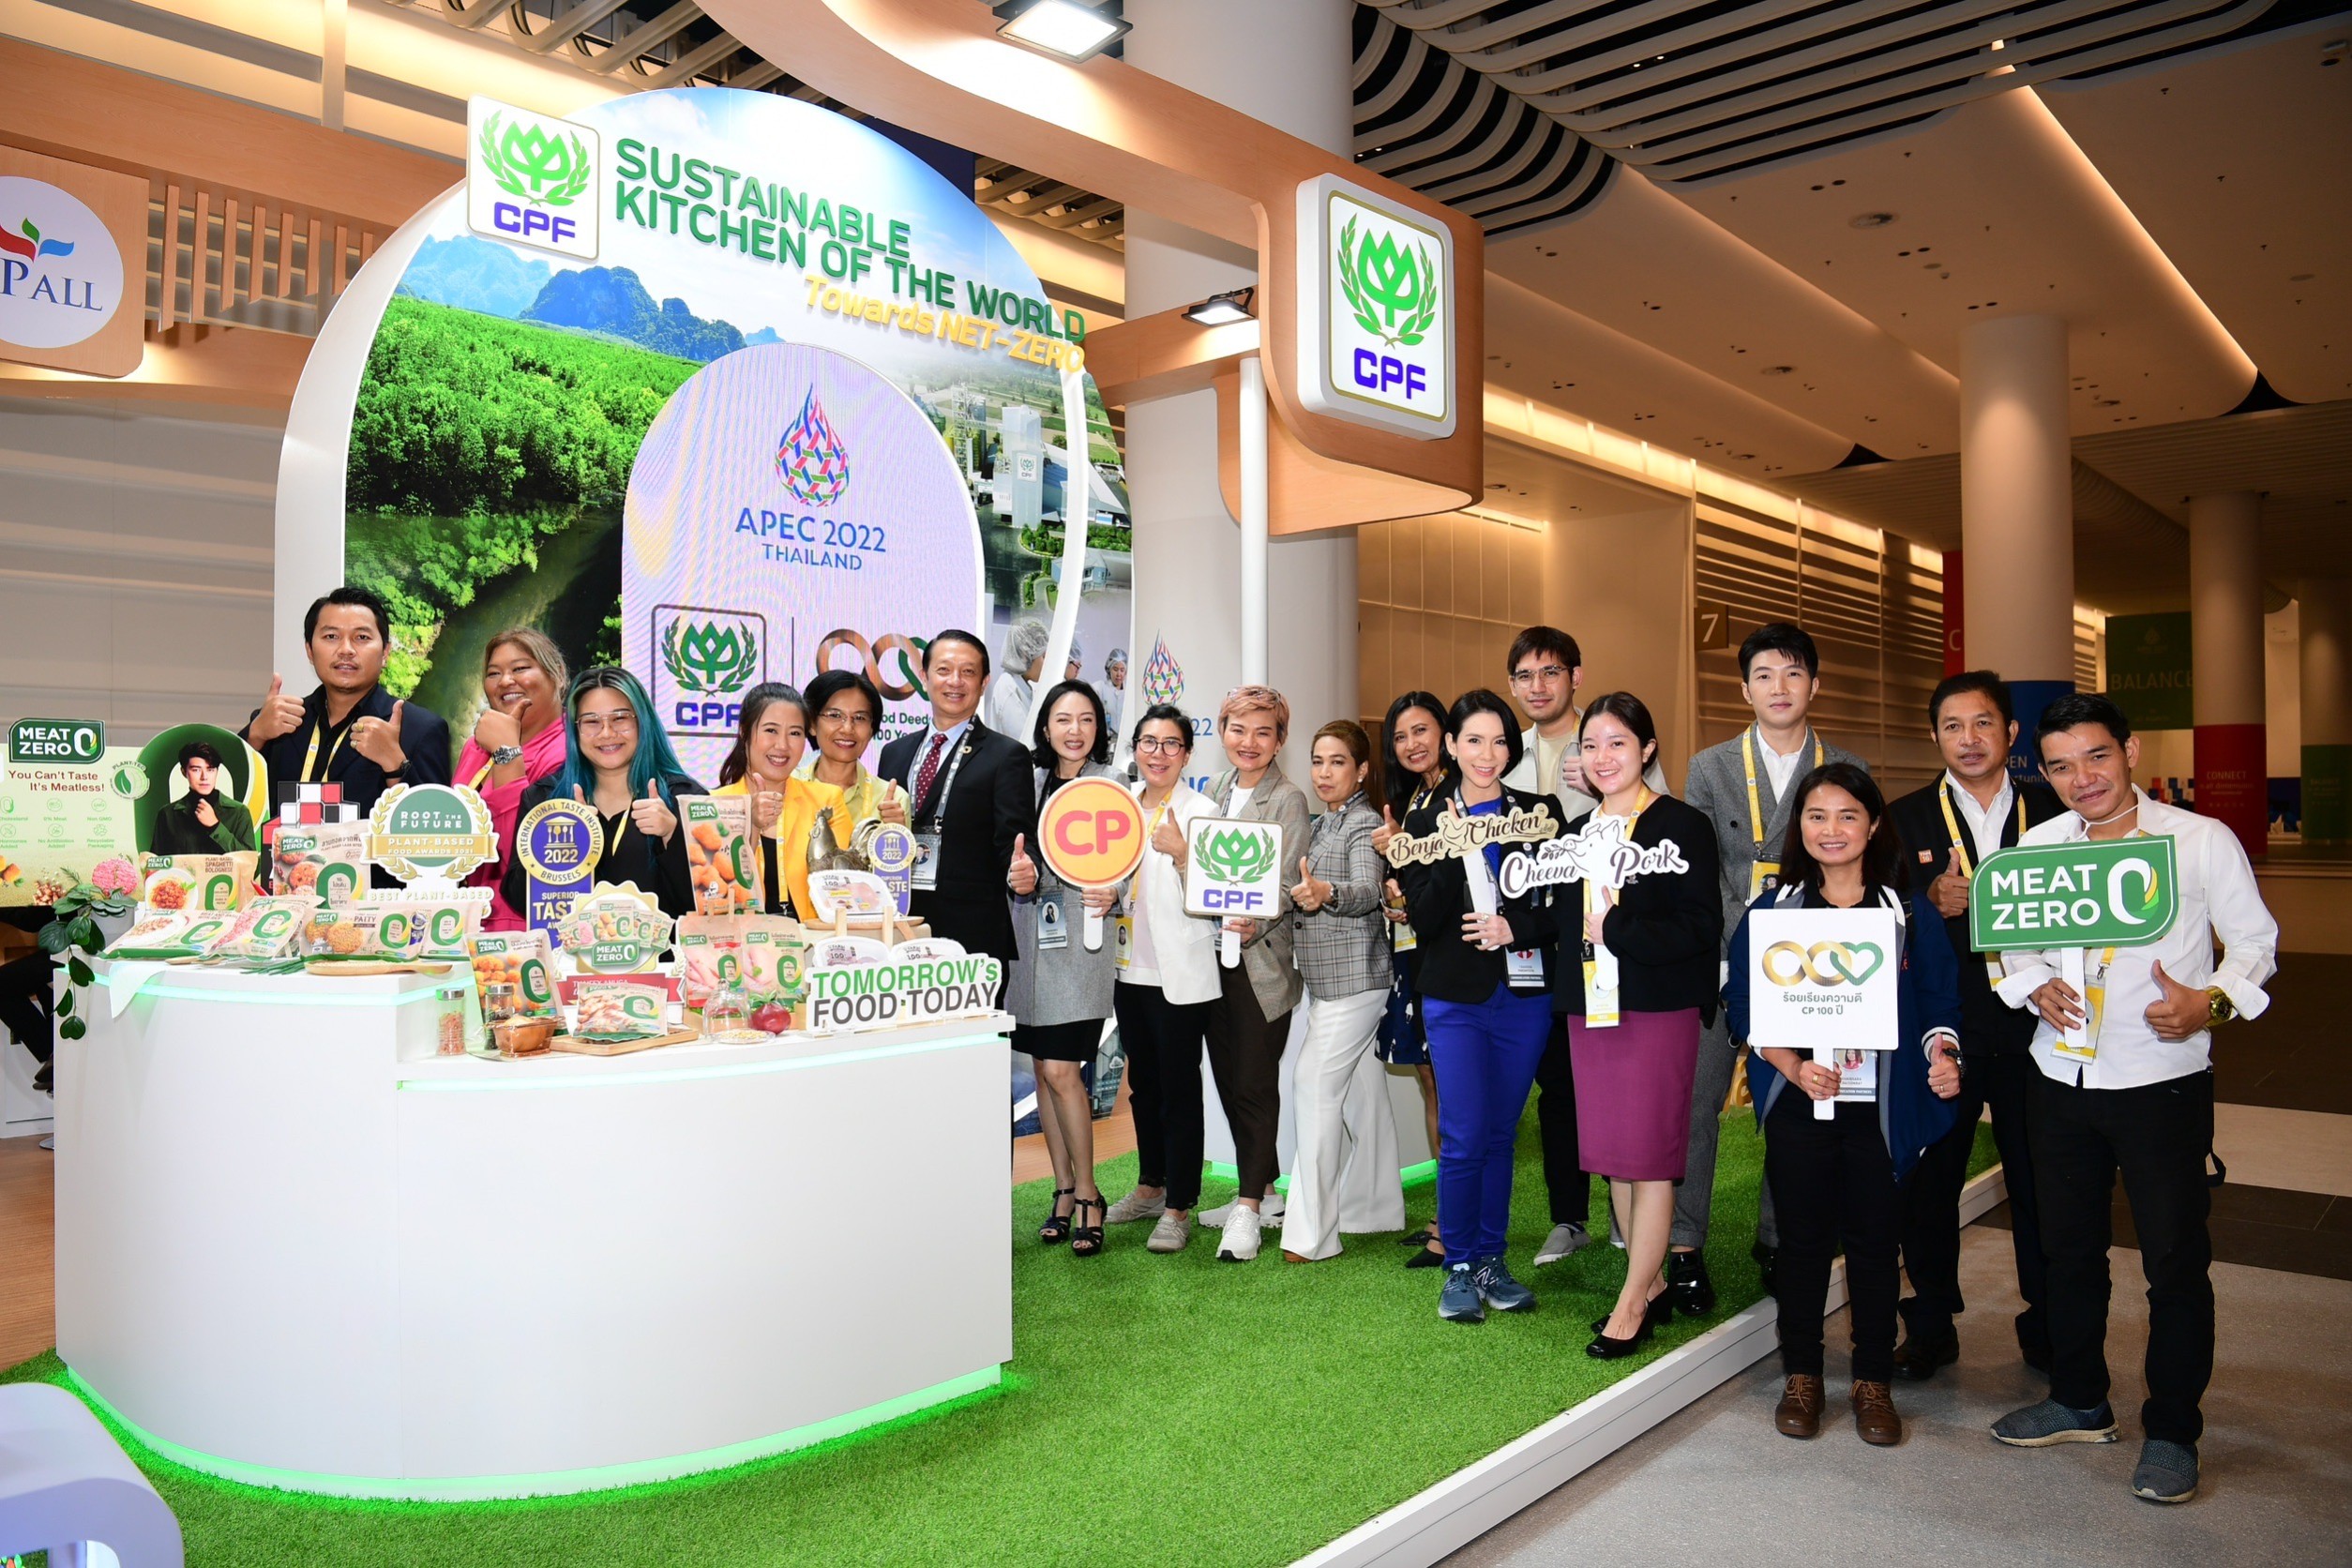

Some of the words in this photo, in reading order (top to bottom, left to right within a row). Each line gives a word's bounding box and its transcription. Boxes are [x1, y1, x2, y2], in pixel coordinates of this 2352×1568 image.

[616, 138, 911, 259] SUSTAINABLE
[494, 202, 576, 243] CPF
[616, 180, 807, 268] KITCHEN
[821, 240, 873, 282] OF
[884, 256, 956, 309] THE
[966, 280, 1086, 342] WORLD
[0, 258, 29, 296] P
[28, 274, 103, 311] ALL
[806, 275, 935, 335] Towards
[938, 310, 1086, 373] NET-ZERO
[1353, 347, 1425, 400] CPF
[735, 507, 816, 543] APEC
[822, 520, 887, 553] 2022
[761, 543, 863, 571] THAILAND
[1700, 613, 1719, 642] 7
[881, 713, 896, 724] od
[899, 713, 931, 725] Deed
[1190, 717, 1214, 736] 22
[19, 727, 71, 741] MEAT
[19, 741, 72, 756] ZERO
[8, 770, 32, 779] You
[35, 770, 66, 780] Can't
[68, 771, 98, 780] Taste
[30, 782, 48, 792] It's
[51, 783, 105, 792] Meatless!
[400, 811, 441, 820] ROOT
[520, 802, 557, 857] INTERNATIONAL
[561, 802, 585, 816] TASTE
[584, 813, 601, 855] INSTITUTE
[388, 837, 475, 846] PLANT-BASED
[1054, 809, 1131, 856] CP
[1390, 836, 1445, 864] Benja
[1468, 810, 1541, 846] Chicken
[544, 849, 579, 864] 2022
[882, 852, 901, 860] 2022
[1503, 856, 1578, 894] Cheeva
[1609, 843, 1684, 884] Pork
[540, 869, 581, 882] BRUSSELS
[1990, 864, 2098, 897] MEAT
[369, 891, 400, 901] BEST
[406, 890, 492, 900] PLANT-BASED
[1202, 888, 1263, 911] CPF
[1991, 897, 2101, 930] ZERO
[596, 945, 623, 954] MEAT
[812, 957, 998, 999] TOMORROW's
[814, 993, 898, 1027] FOOD
[907, 982, 997, 1016] TODAY
[1783, 991, 1862, 1003] ร้อยเรียงความดี
[1802, 1006, 1815, 1015] CP
[1817, 1006, 1833, 1015] 100
